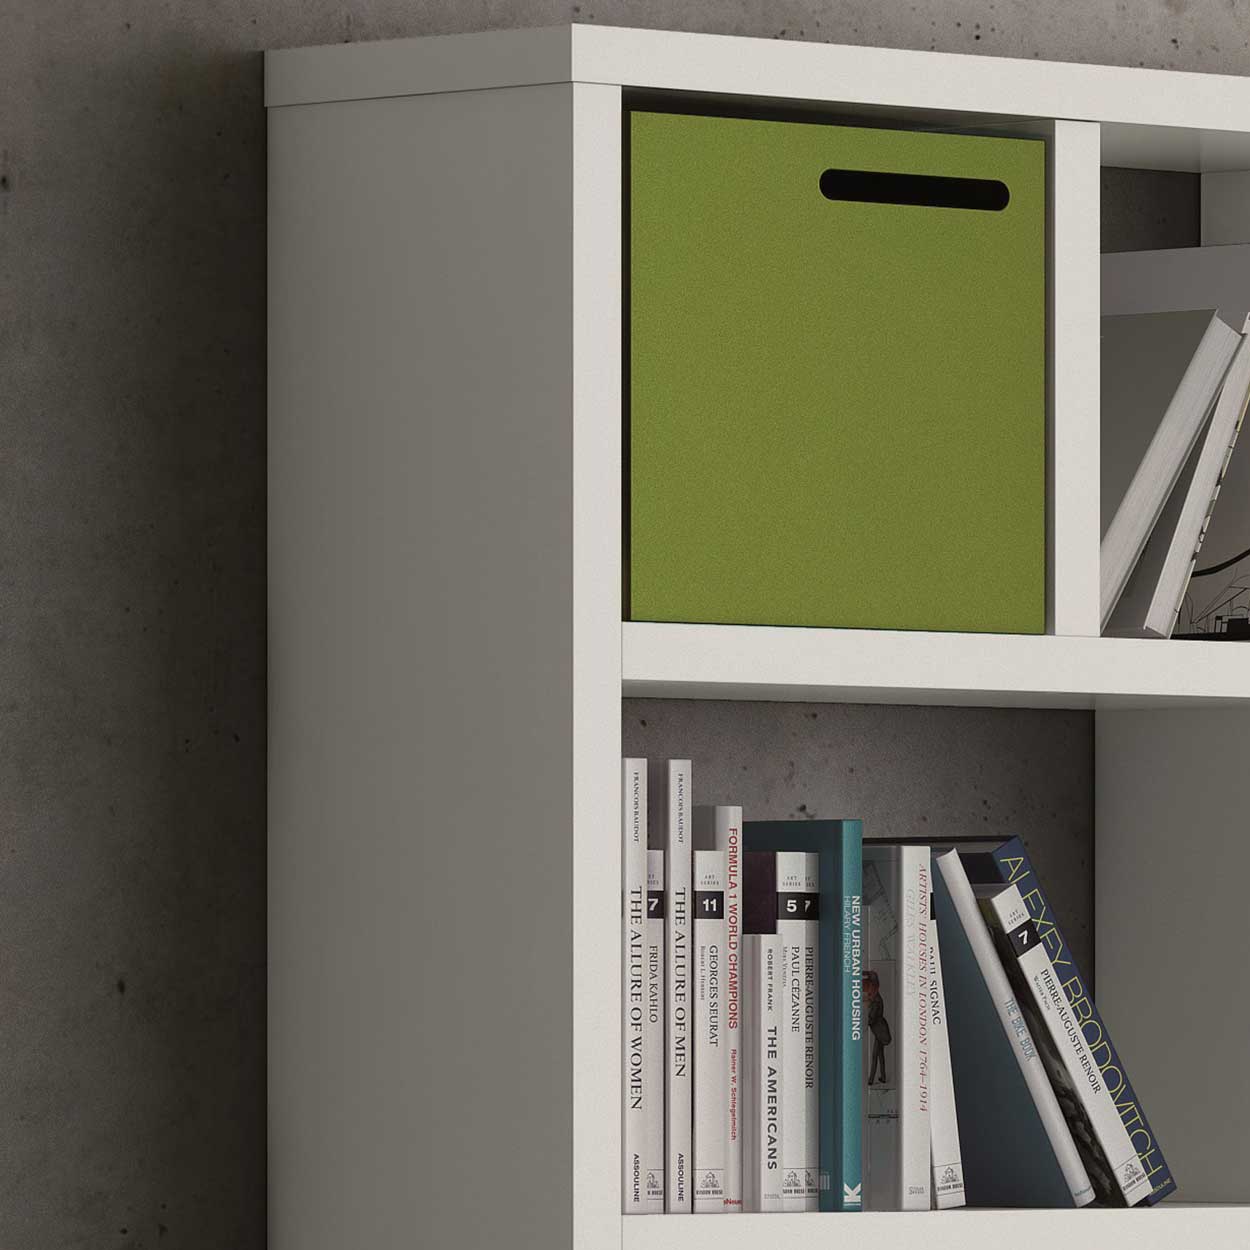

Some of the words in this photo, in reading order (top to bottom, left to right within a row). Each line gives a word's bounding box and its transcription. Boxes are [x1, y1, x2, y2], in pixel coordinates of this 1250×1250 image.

[729, 828, 738, 890] FORMULA
[630, 886, 642, 926] THE
[675, 887, 686, 927] THE
[702, 898, 717, 912] 11
[729, 903, 738, 950] WORLD
[786, 900, 798, 912] 5
[1018, 930, 1029, 945] 7
[630, 929, 642, 1003] ALLURE
[649, 945, 659, 977] FRIDA
[675, 930, 686, 1003] ALLURE
[708, 945, 719, 995] GEORGES
[649, 982, 659, 1024] KAHLO
[729, 953, 738, 1030] CHAMPIONS
[805, 946, 814, 1045] PIERRE-AUGUSTE
[630, 1009, 642, 1033] OF
[675, 1008, 686, 1033] OF
[708, 997, 719, 1047] SEURAT
[1000, 857, 1072, 966] ALEXEY
[1062, 975, 1163, 1177] BRODOVITCH
[675, 1036, 686, 1078] MEN
[767, 1026, 778, 1059] THE
[630, 1035, 642, 1111] WOMEN
[731, 1076, 737, 1085] W.
[805, 1046, 814, 1090] RENOIR
[767, 1066, 778, 1171] AMERICANS
